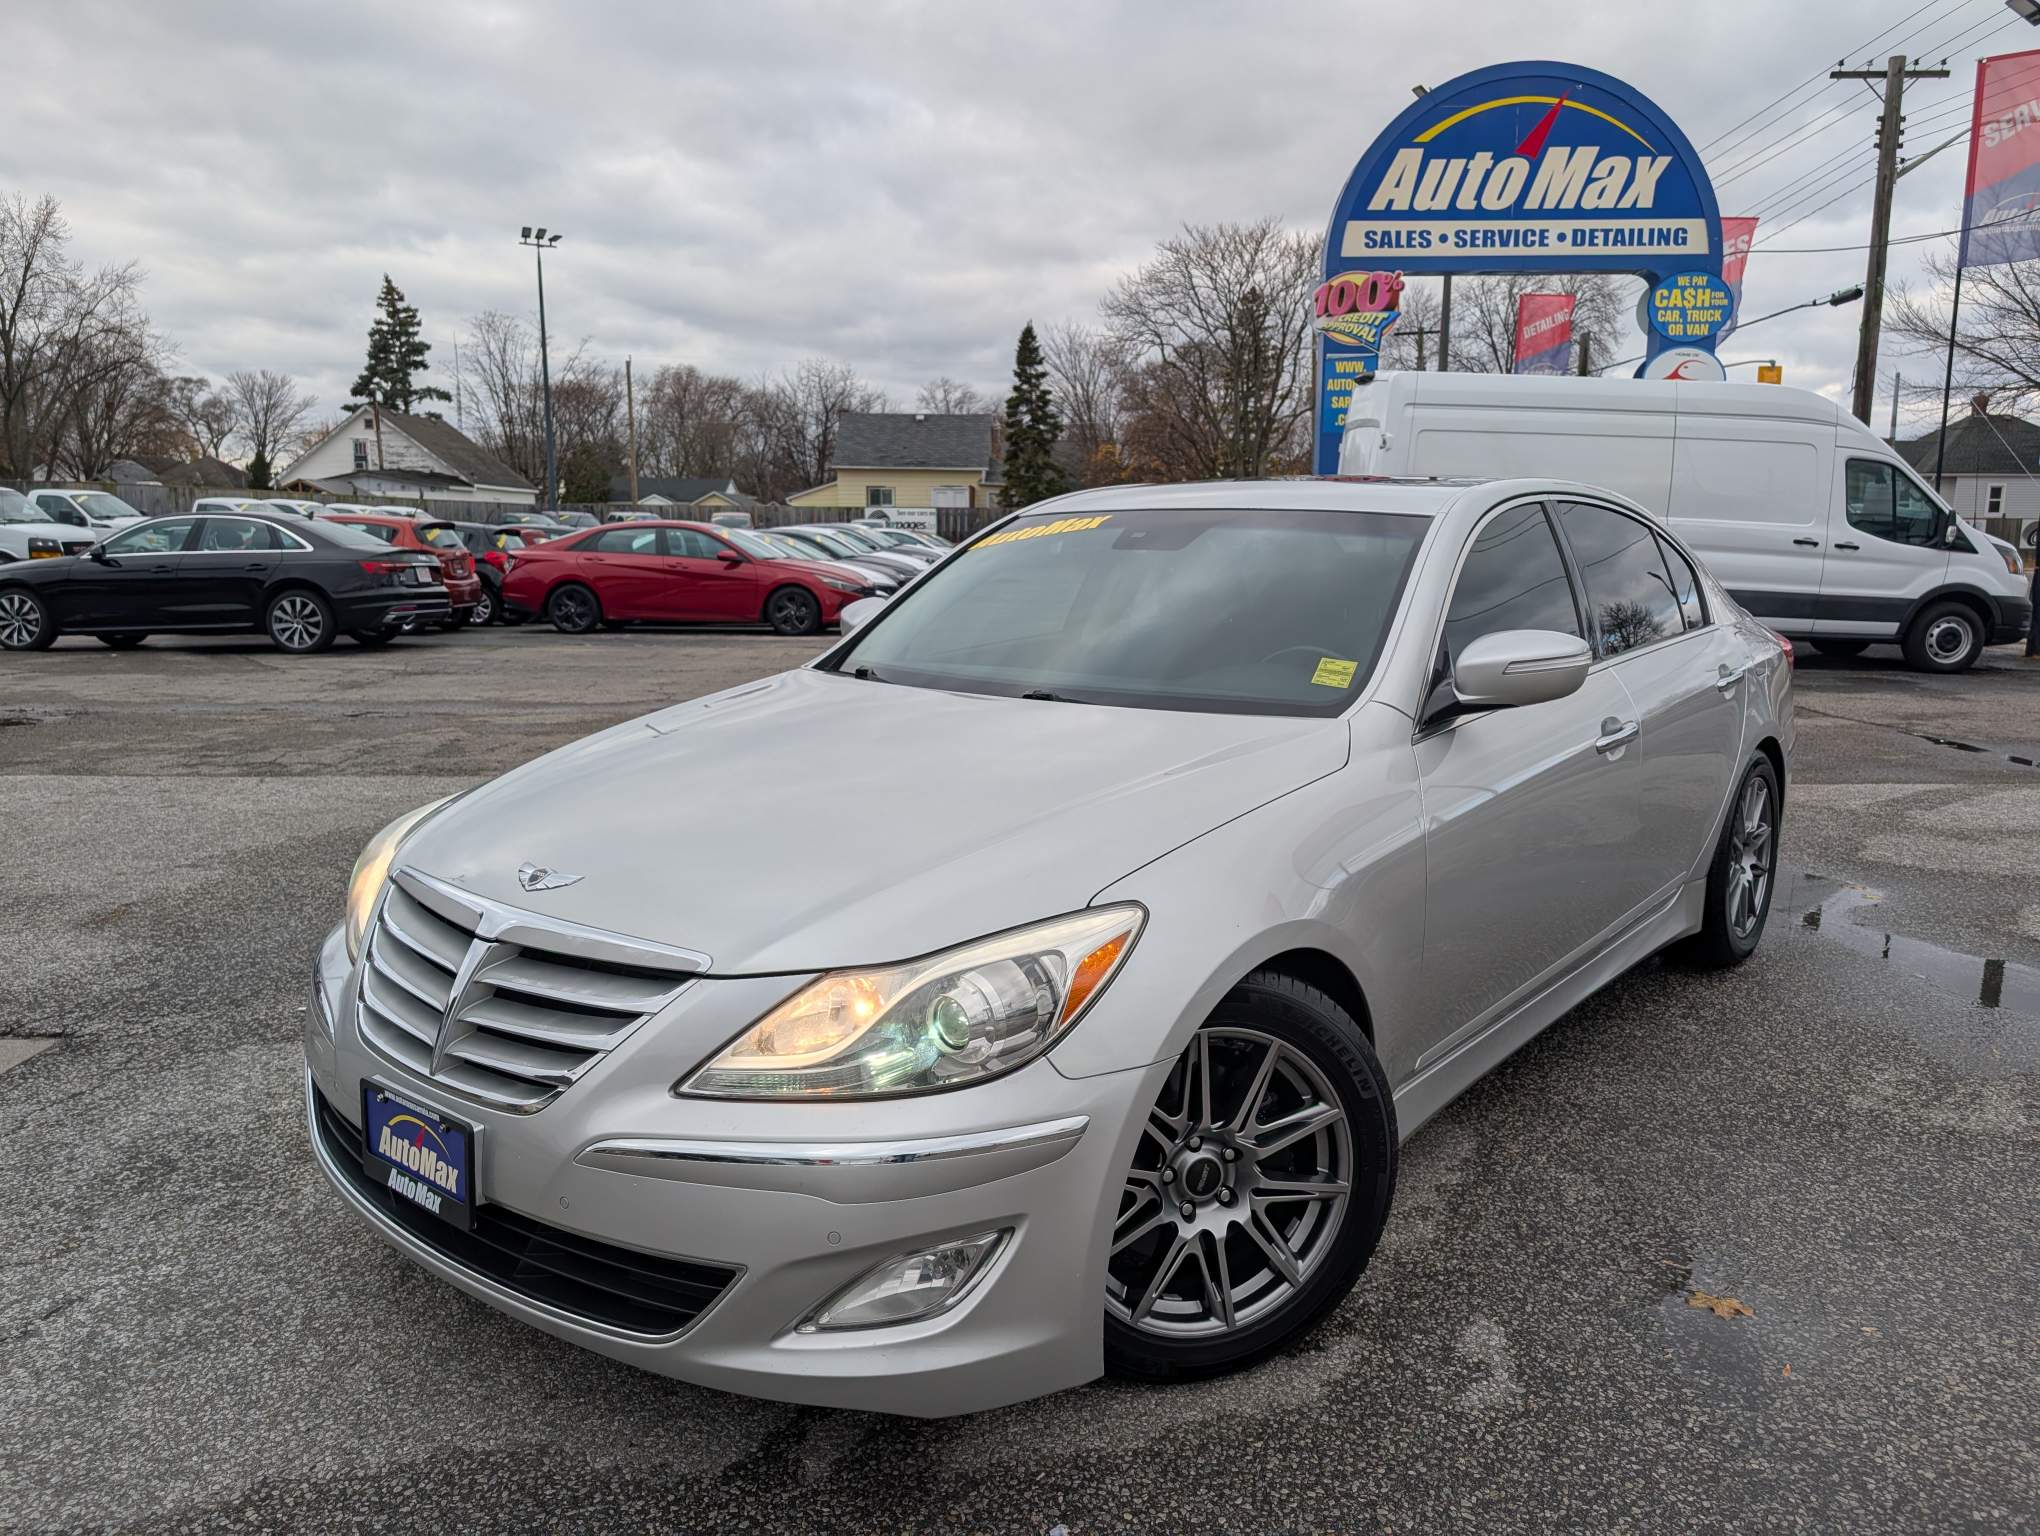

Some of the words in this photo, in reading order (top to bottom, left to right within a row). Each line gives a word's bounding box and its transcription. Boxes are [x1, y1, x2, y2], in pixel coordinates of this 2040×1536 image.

[1367, 146, 1672, 211] AutoMax
[1364, 229, 1432, 249] SALES
[1454, 228, 1549, 248] SERVICE
[1571, 227, 1688, 247] DETAILING
[1677, 276, 1691, 286] WE
[1692, 276, 1708, 286] PAY
[1312, 270, 1405, 317] 100%
[1654, 287, 1711, 309] CA$H
[1711, 291, 1725, 299] FOR
[1338, 311, 1390, 326] CREDIT
[1523, 308, 1569, 339] DETAILING
[1657, 310, 1683, 324] CAR,
[1687, 309, 1722, 322] TRUCK
[1668, 324, 1683, 336] OR
[1686, 324, 1709, 336] VAN
[1335, 361, 1367, 374] WWW.
[1294, 1014, 1373, 1094] ICHELIN
[378, 1125, 459, 1194] AutoMax
[387, 1168, 442, 1214] AutoMax
